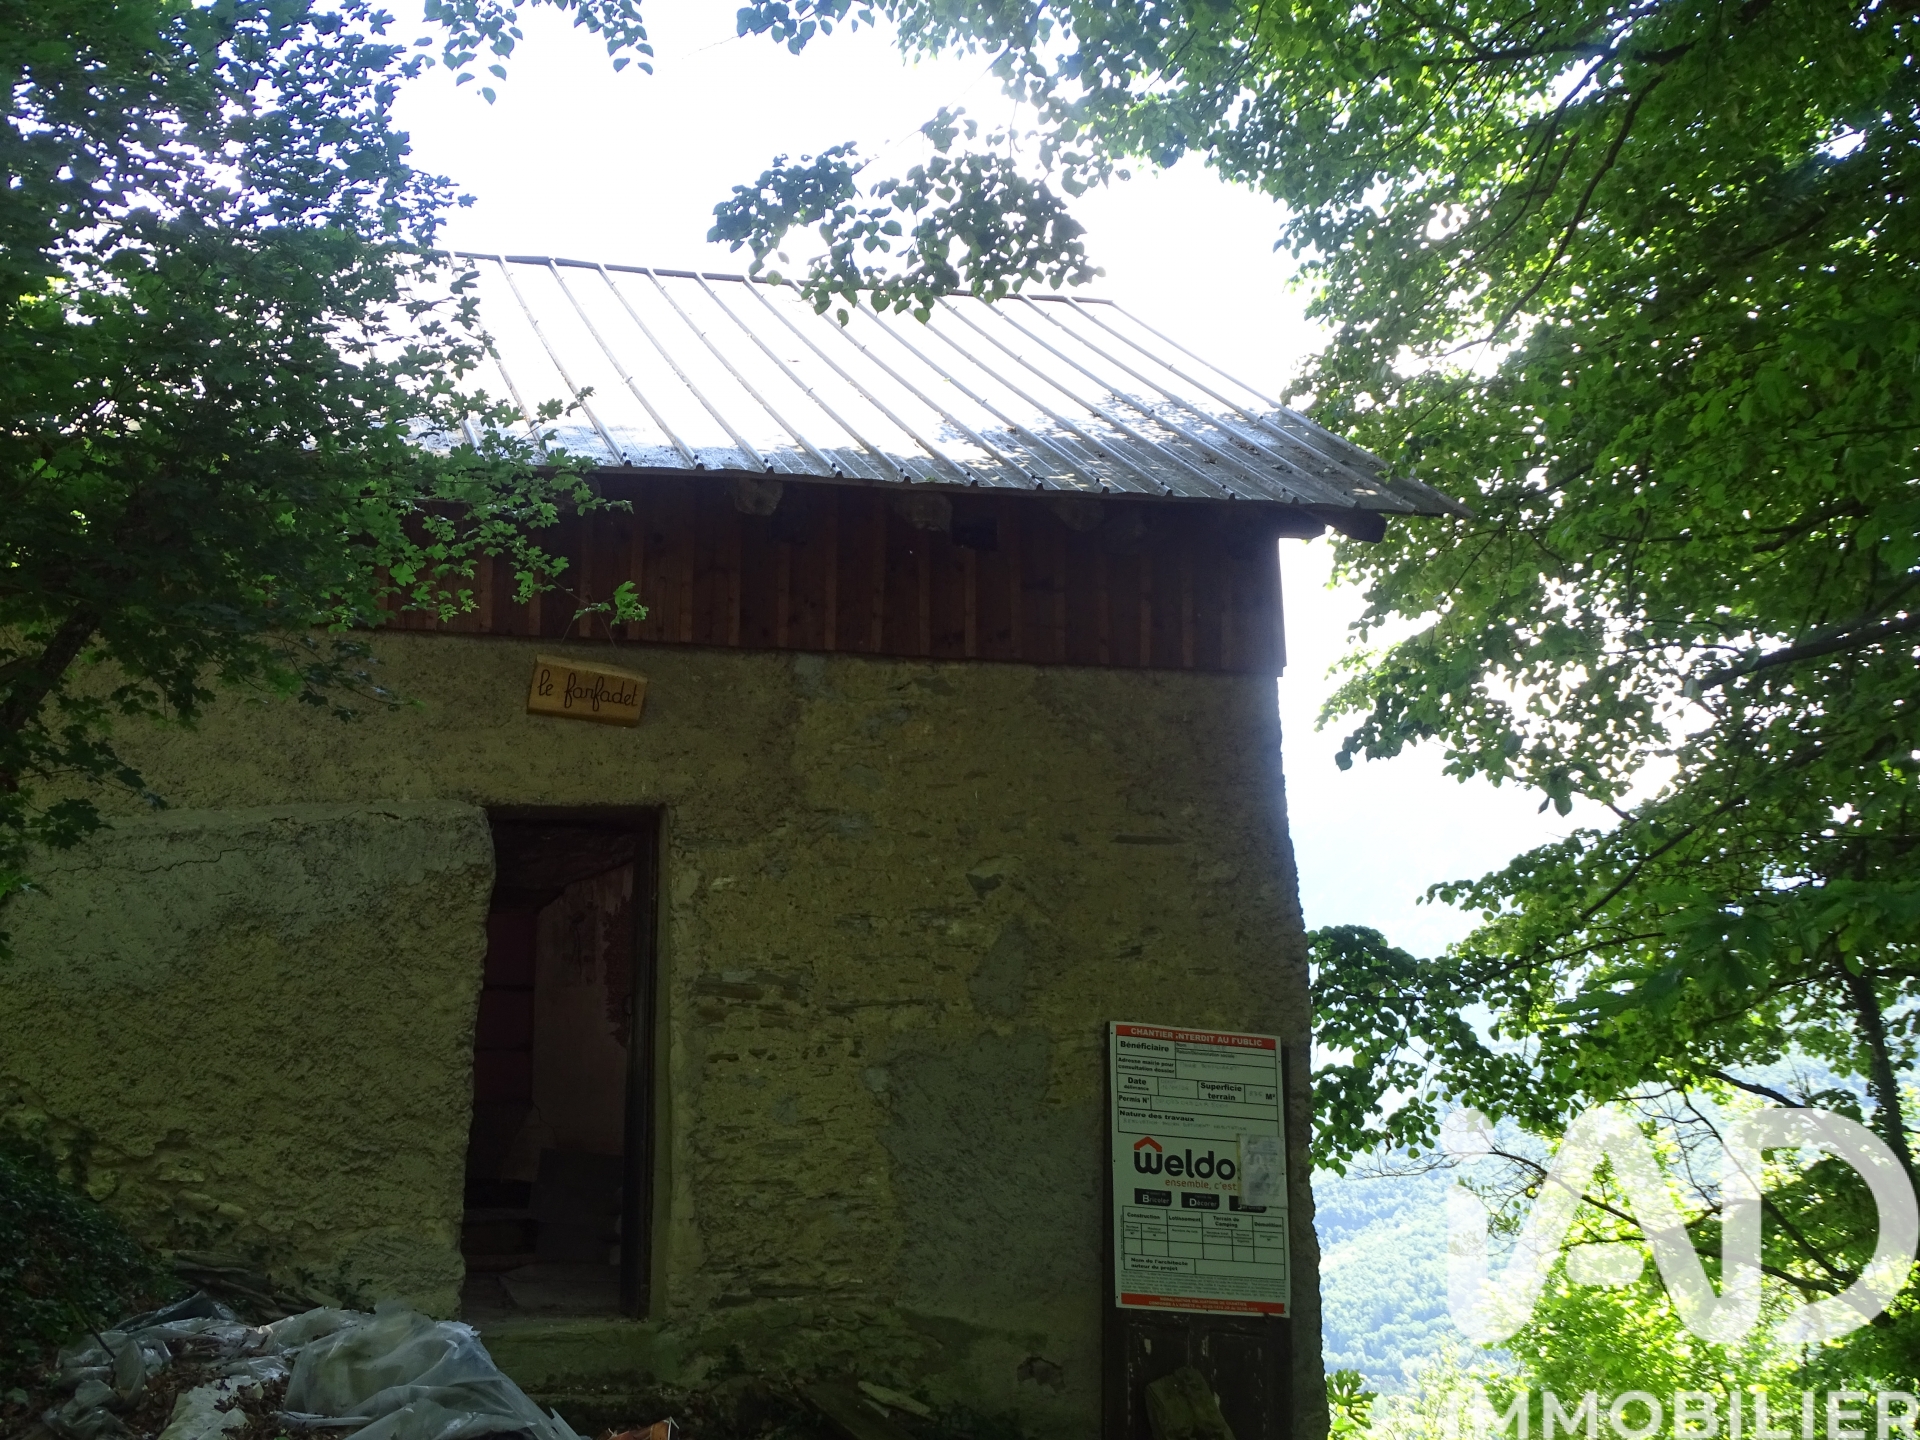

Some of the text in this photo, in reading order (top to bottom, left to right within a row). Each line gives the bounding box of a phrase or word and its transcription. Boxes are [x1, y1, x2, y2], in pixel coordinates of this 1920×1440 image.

[537, 669, 638, 712] le farfadet
[1130, 1027, 1262, 1047] CHANTIER INTERDIT AU PUBLIC
[1120, 1040, 1169, 1053] Bénéficiaire
[1118, 1064, 1153, 1072] consultation
[1154, 1066, 1174, 1074] dossier
[1127, 1077, 1147, 1085] Date
[1200, 1082, 1242, 1092] Superficie
[1118, 1094, 1140, 1103] Permis
[1208, 1092, 1236, 1101] terrain
[1119, 1110, 1146, 1118] Nature
[1134, 1149, 1236, 1180] weldo
[1165, 1178, 1237, 1191] ensemble, c'est
[1142, 1194, 1170, 1204] Bricoler
[1189, 1197, 1217, 1207] Décorer
[1127, 1212, 1160, 1220] Construction
